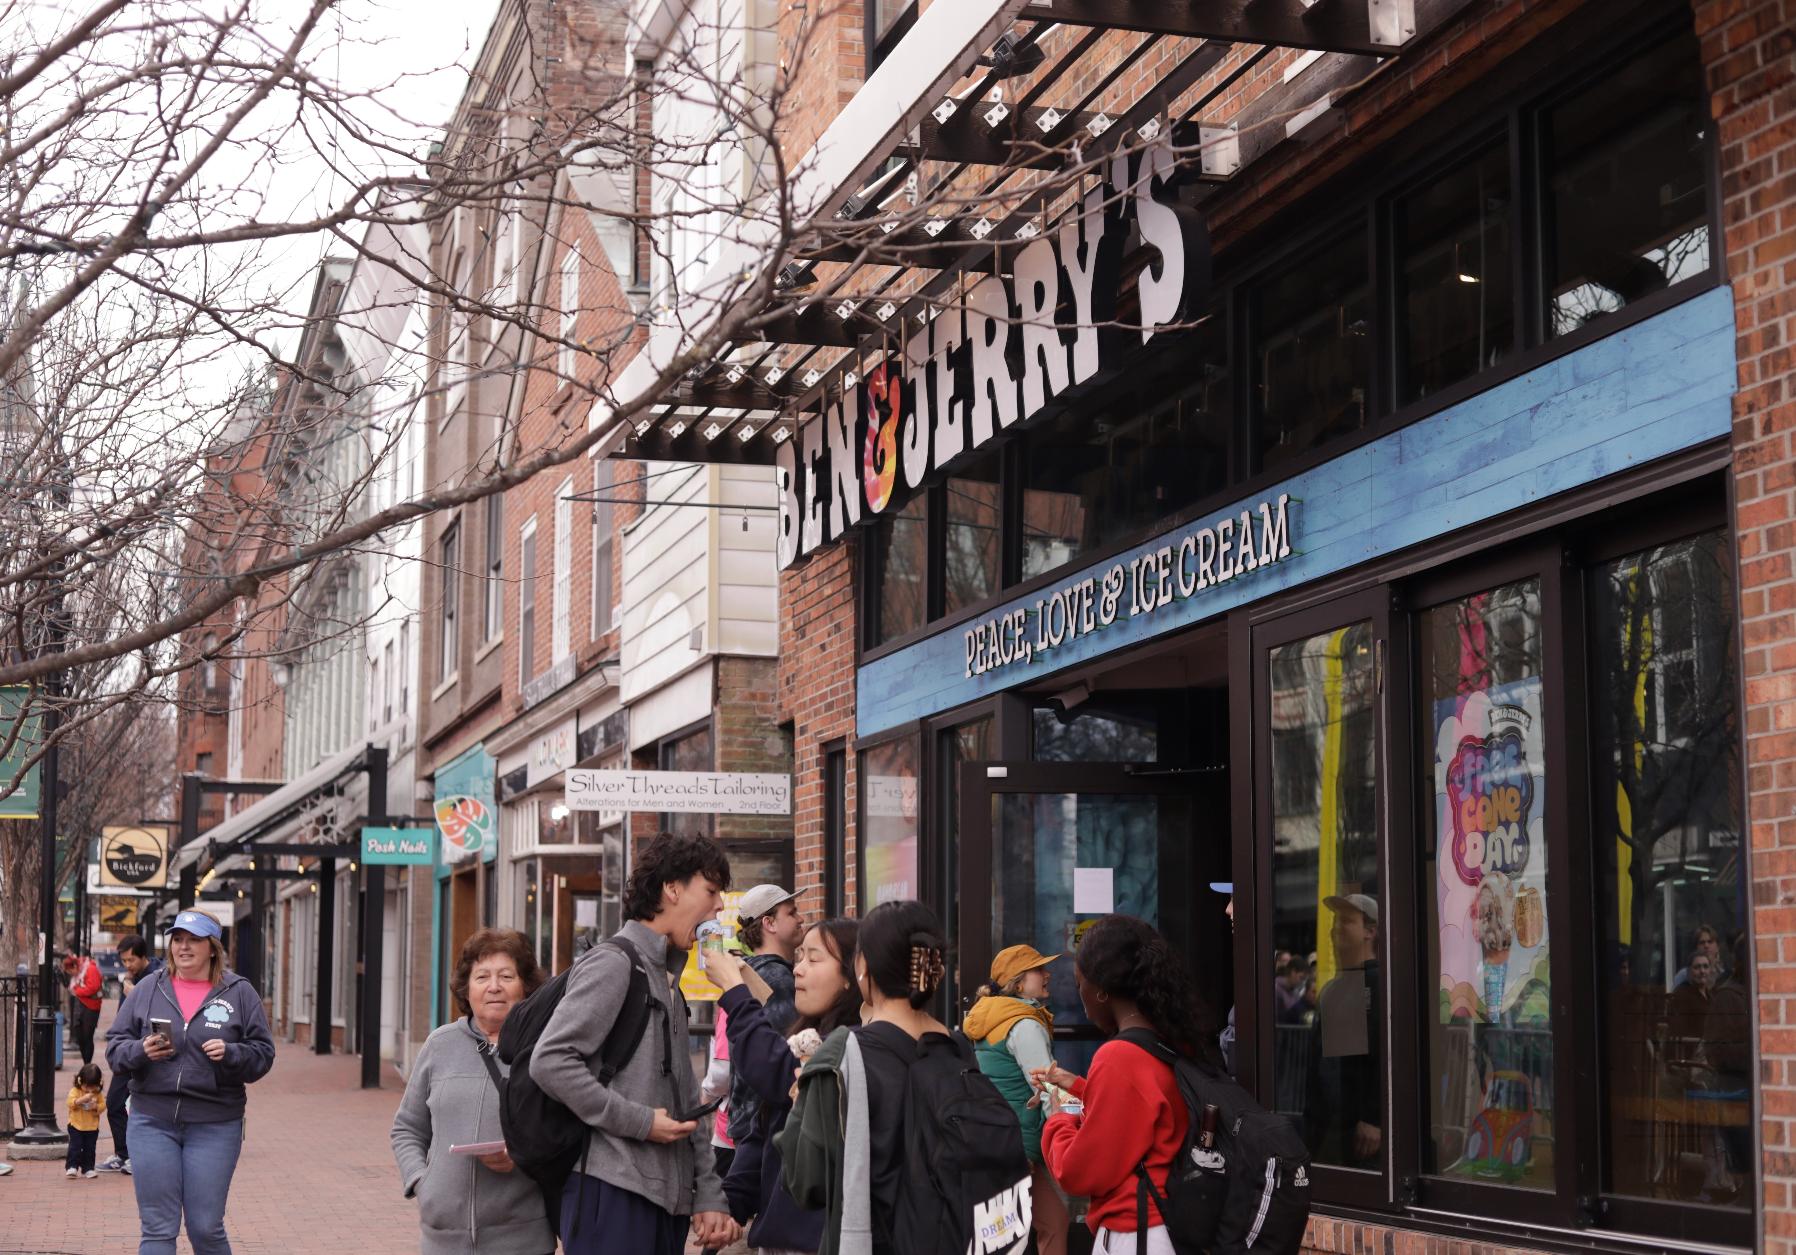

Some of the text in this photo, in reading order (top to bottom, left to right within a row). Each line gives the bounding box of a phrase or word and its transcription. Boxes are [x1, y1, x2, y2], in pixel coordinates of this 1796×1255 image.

[776, 381, 861, 572] BEN
[902, 119, 1185, 489] JERRY'S
[964, 493, 1291, 679] PEACE, LOVE & ICE CREAM
[569, 773, 788, 802] Silver Threads Tailoring
[576, 797, 782, 811] Alterations for Men and Women 2nd Floor
[1461, 786, 1521, 834] CONE
[367, 838, 428, 854] Posh Nails
[112, 861, 156, 871] Bickford
[981, 1212, 1016, 1238] DREAM
